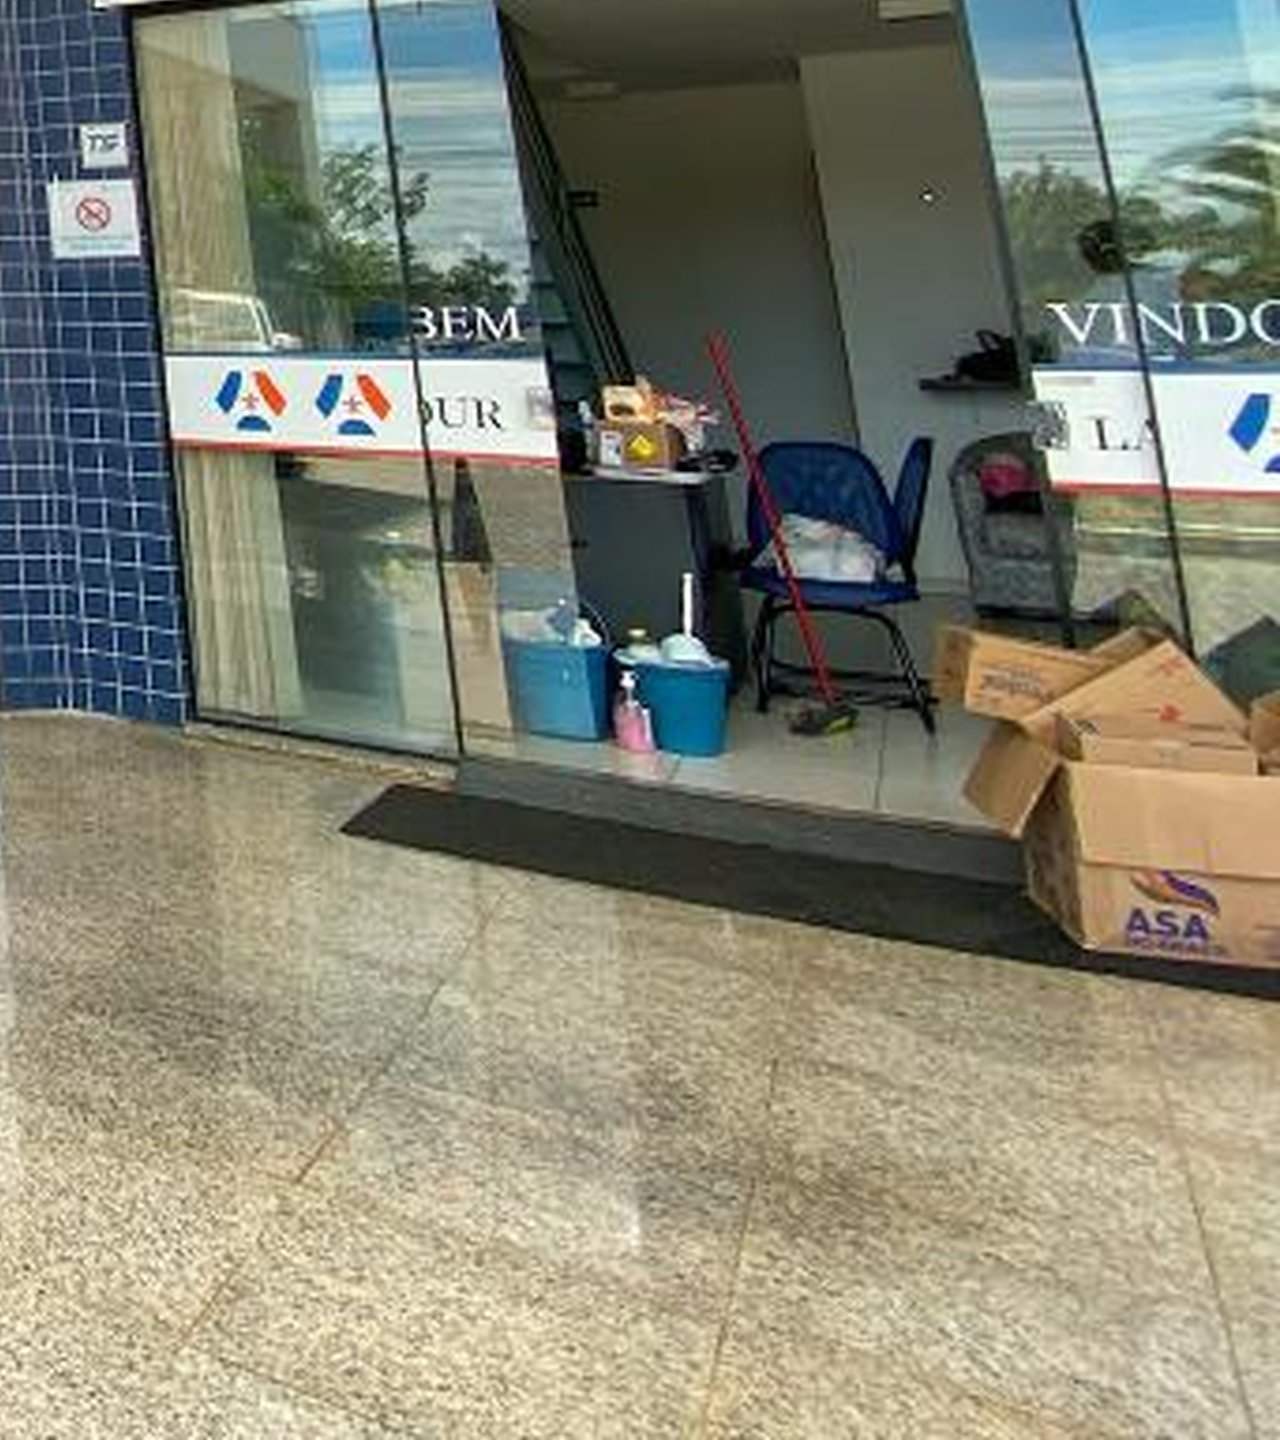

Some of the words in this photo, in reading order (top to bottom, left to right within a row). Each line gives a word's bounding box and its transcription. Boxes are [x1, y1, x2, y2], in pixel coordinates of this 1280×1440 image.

[410, 306, 527, 341] BEM
[1046, 300, 1280, 346] VINDO
[1126, 908, 1208, 940] ASA
